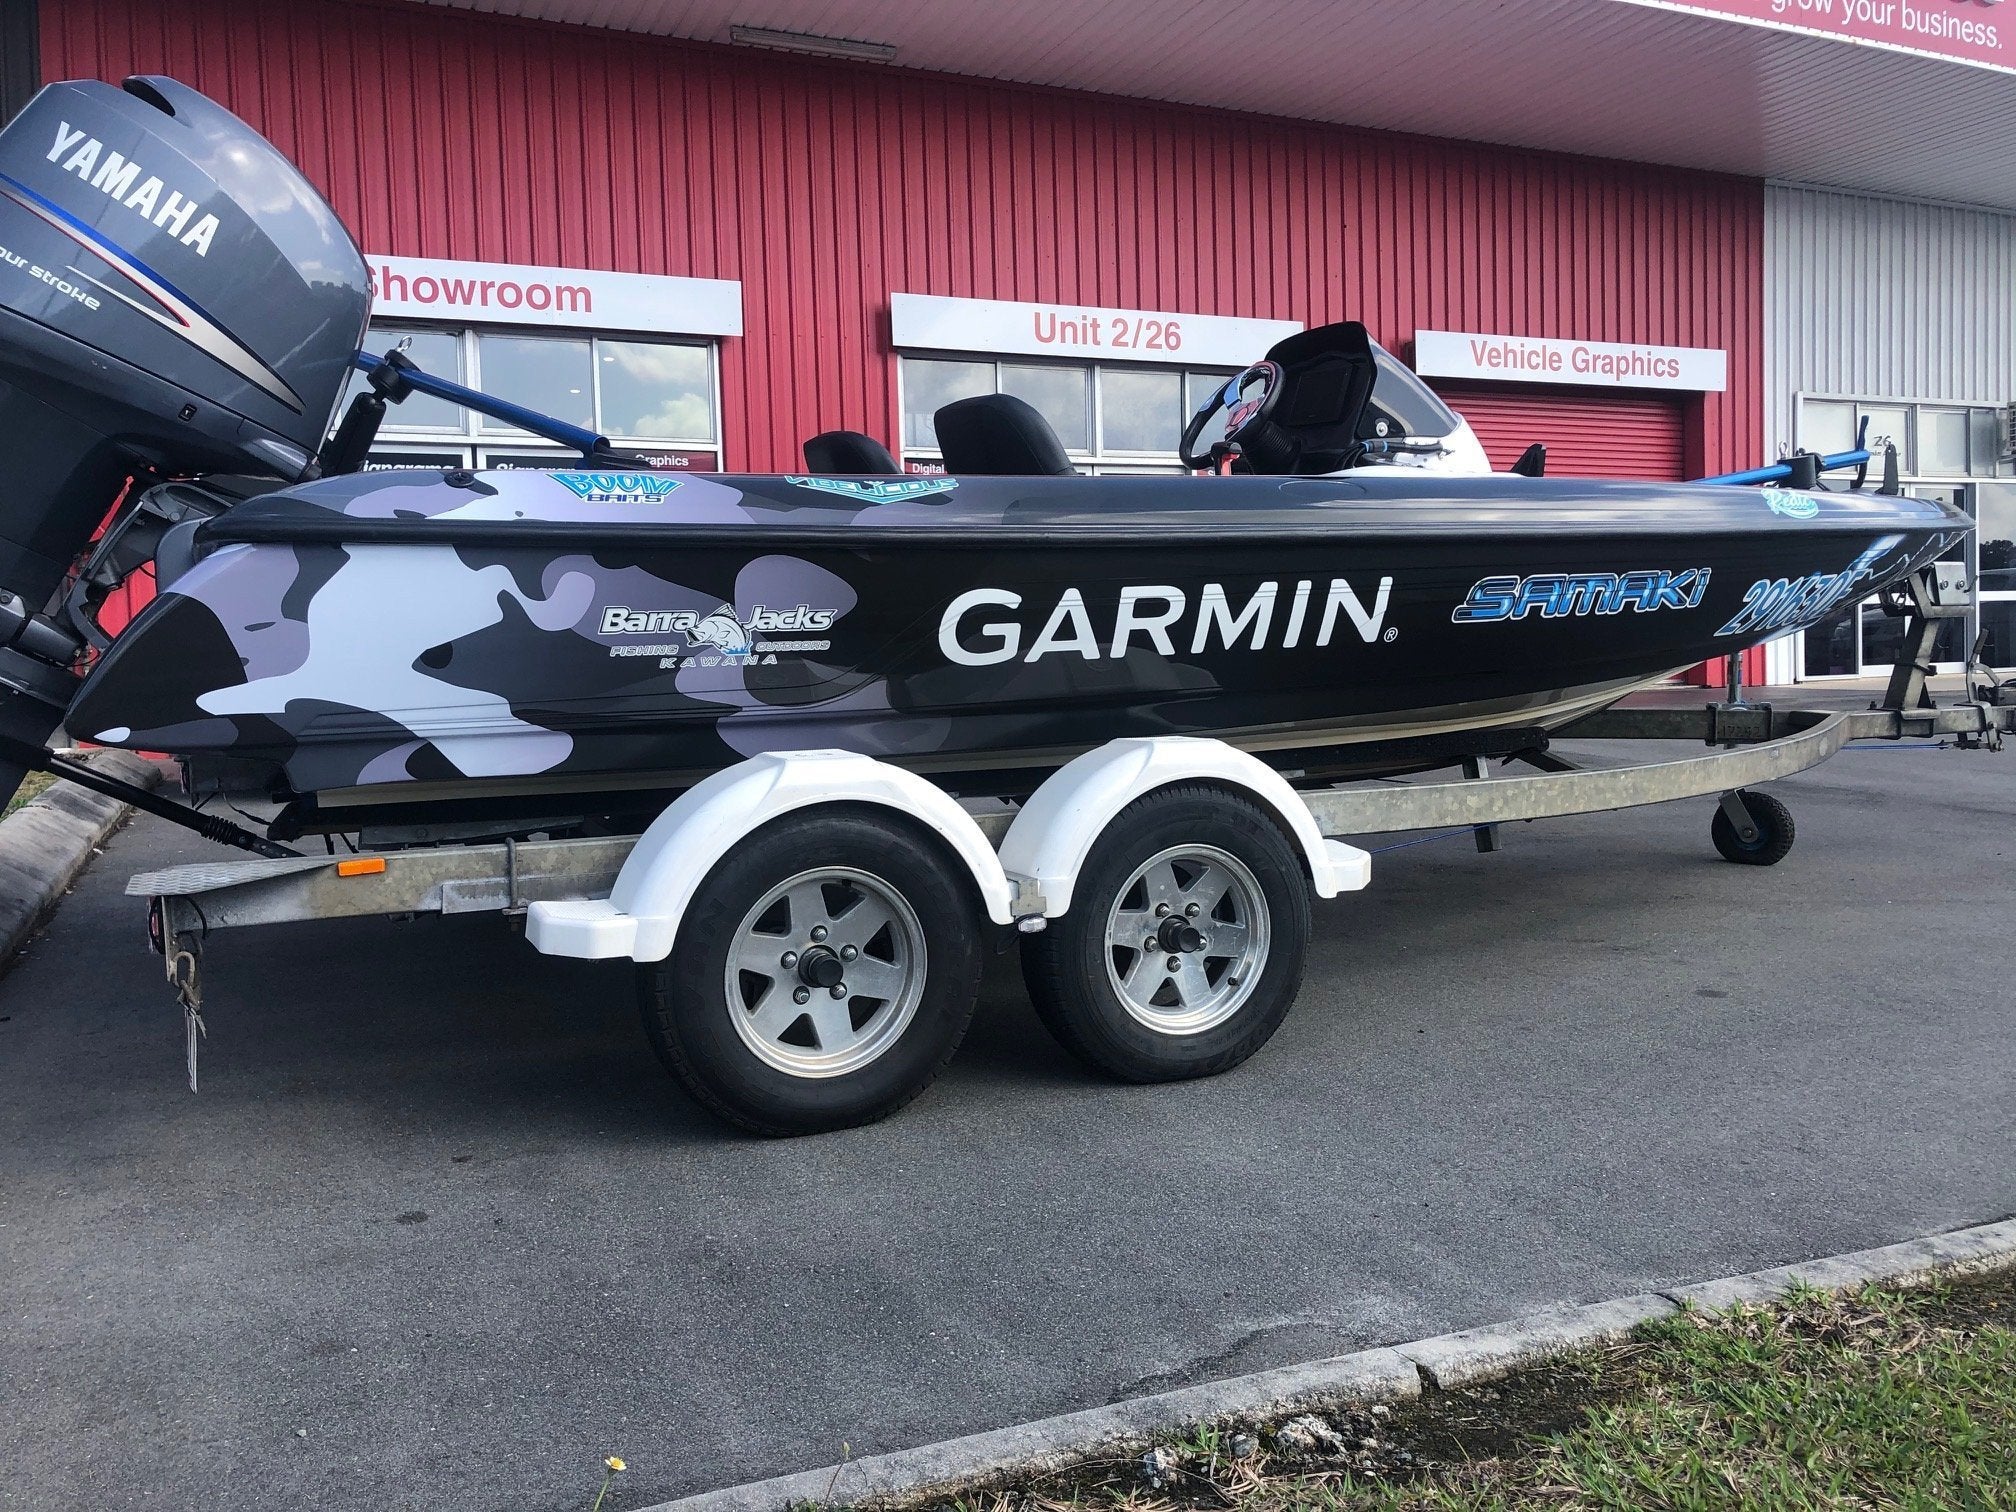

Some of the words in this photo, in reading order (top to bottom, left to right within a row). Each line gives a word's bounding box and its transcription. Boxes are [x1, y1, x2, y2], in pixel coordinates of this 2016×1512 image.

[1842, 0, 1896, 26] your
[1902, 0, 2003, 50] business.
[46, 121, 220, 258] YAMAHA
[28, 265, 101, 311] stroke
[1034, 312, 1101, 346] Unit
[1111, 317, 1182, 351] 2/26
[1470, 339, 1563, 372] Vehicle
[1571, 346, 1681, 382] Graphics
[546, 473, 684, 499] BOOM
[912, 463, 945, 475] Digital
[586, 493, 663, 503] BAITS
[1452, 567, 1711, 623] SAMAKI
[598, 605, 700, 635] Barra
[742, 604, 838, 632] Jacks
[610, 643, 680, 658] FISHING
[755, 639, 831, 652] OUTDOORS
[659, 653, 779, 670] KAWANA
